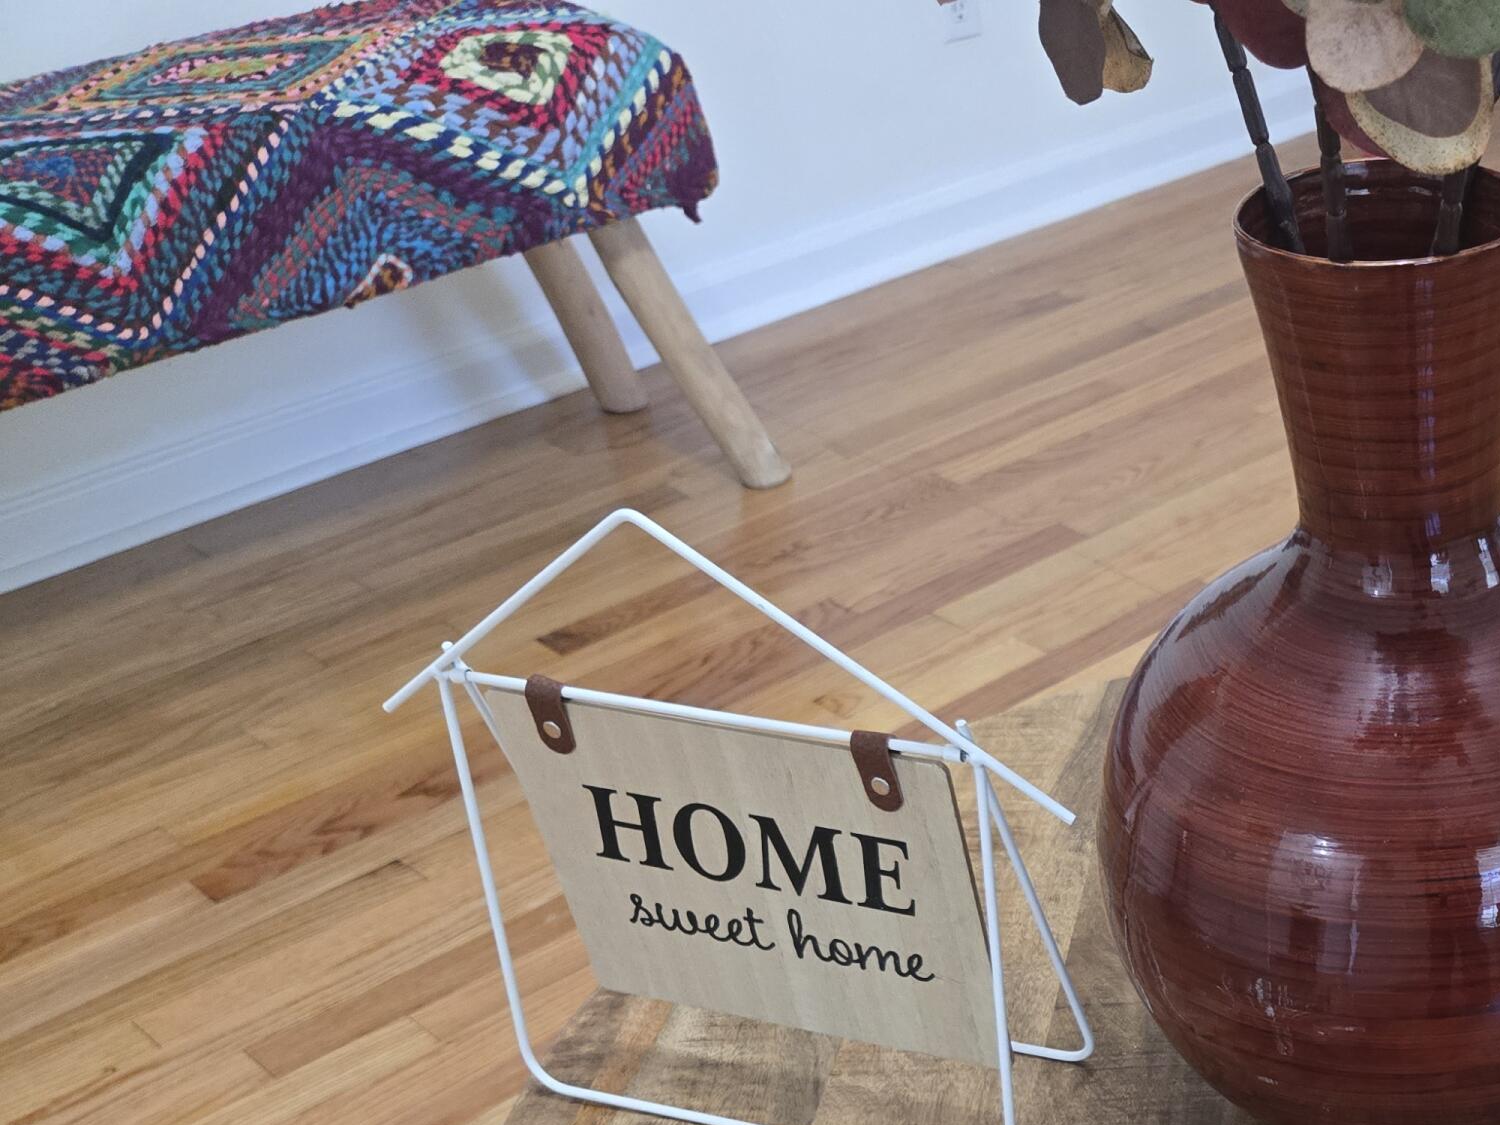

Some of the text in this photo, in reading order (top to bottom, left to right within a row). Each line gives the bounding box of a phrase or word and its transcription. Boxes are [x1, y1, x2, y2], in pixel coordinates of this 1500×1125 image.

[582, 784, 916, 917] HOME
[629, 893, 936, 983] sweet home
